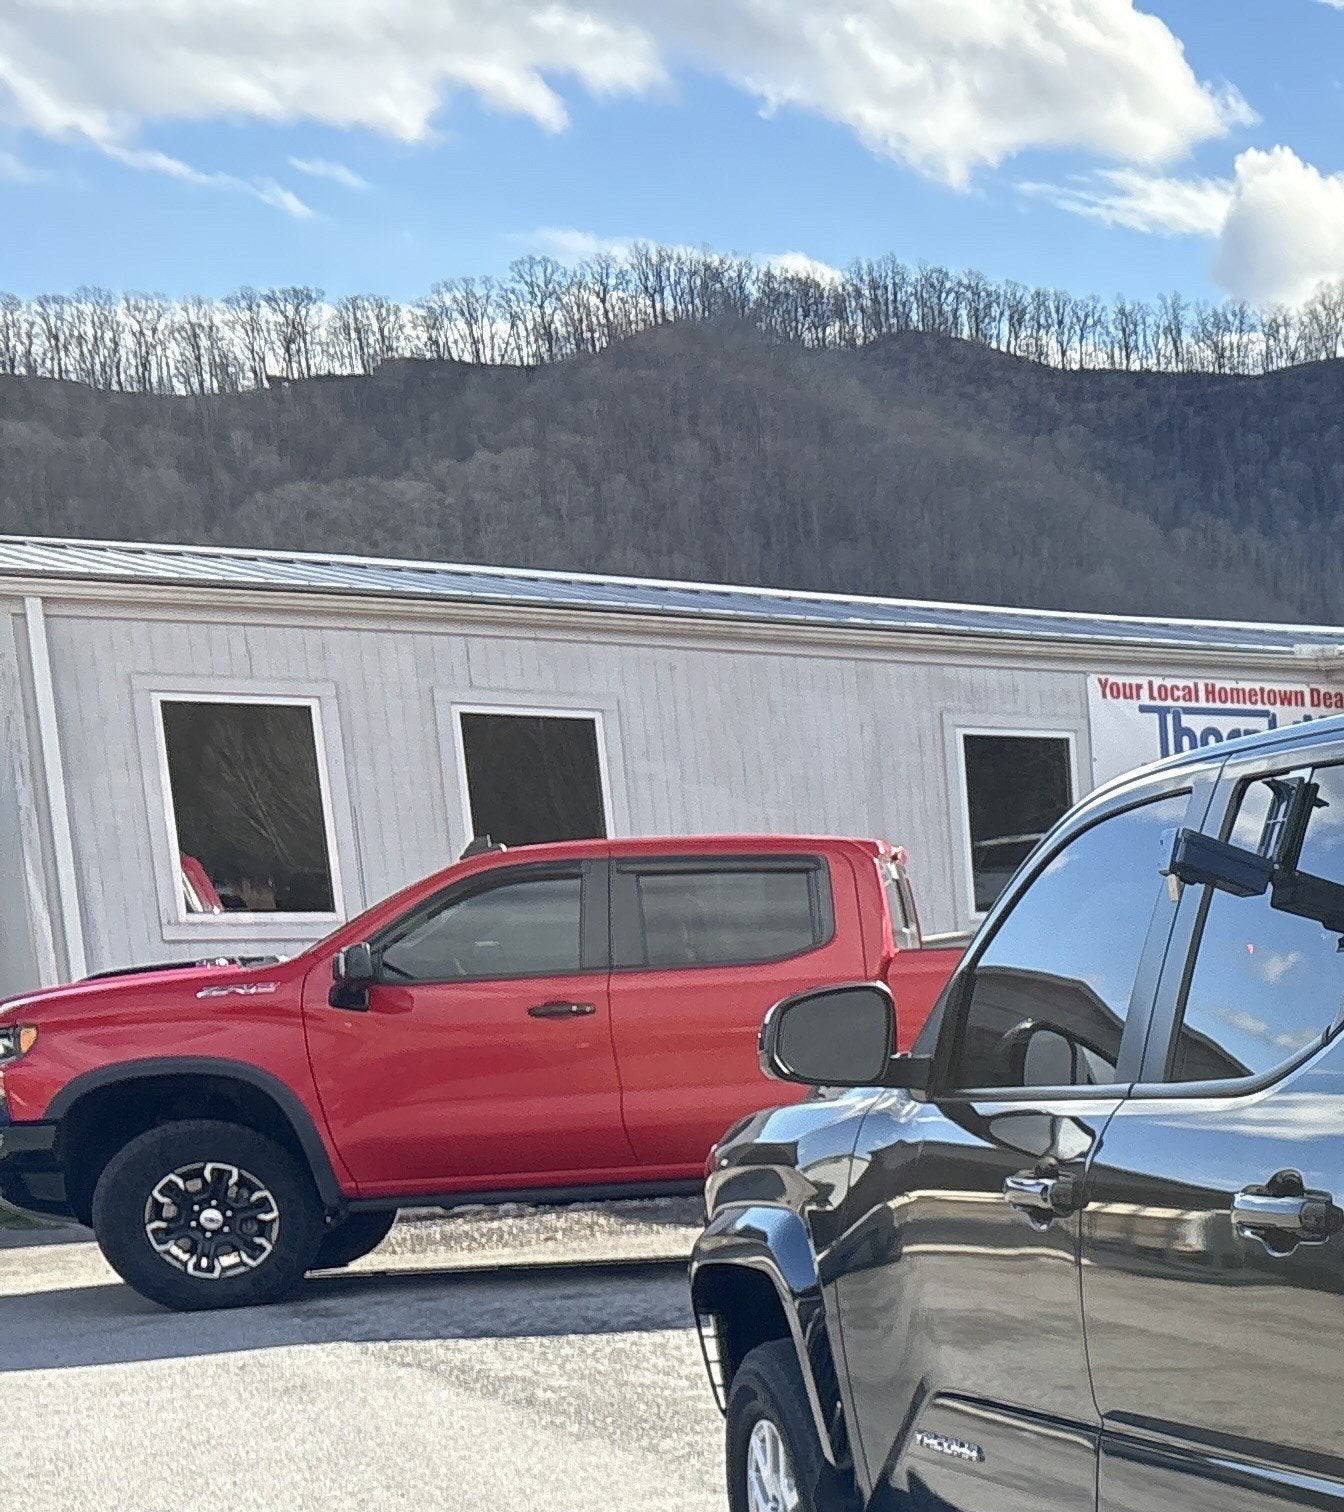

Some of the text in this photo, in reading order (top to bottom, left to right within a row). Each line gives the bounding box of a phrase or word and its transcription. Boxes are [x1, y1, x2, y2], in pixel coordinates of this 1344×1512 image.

[1097, 678, 1143, 701] Your
[1149, 680, 1199, 703] Local
[1204, 684, 1305, 707] Hometown
